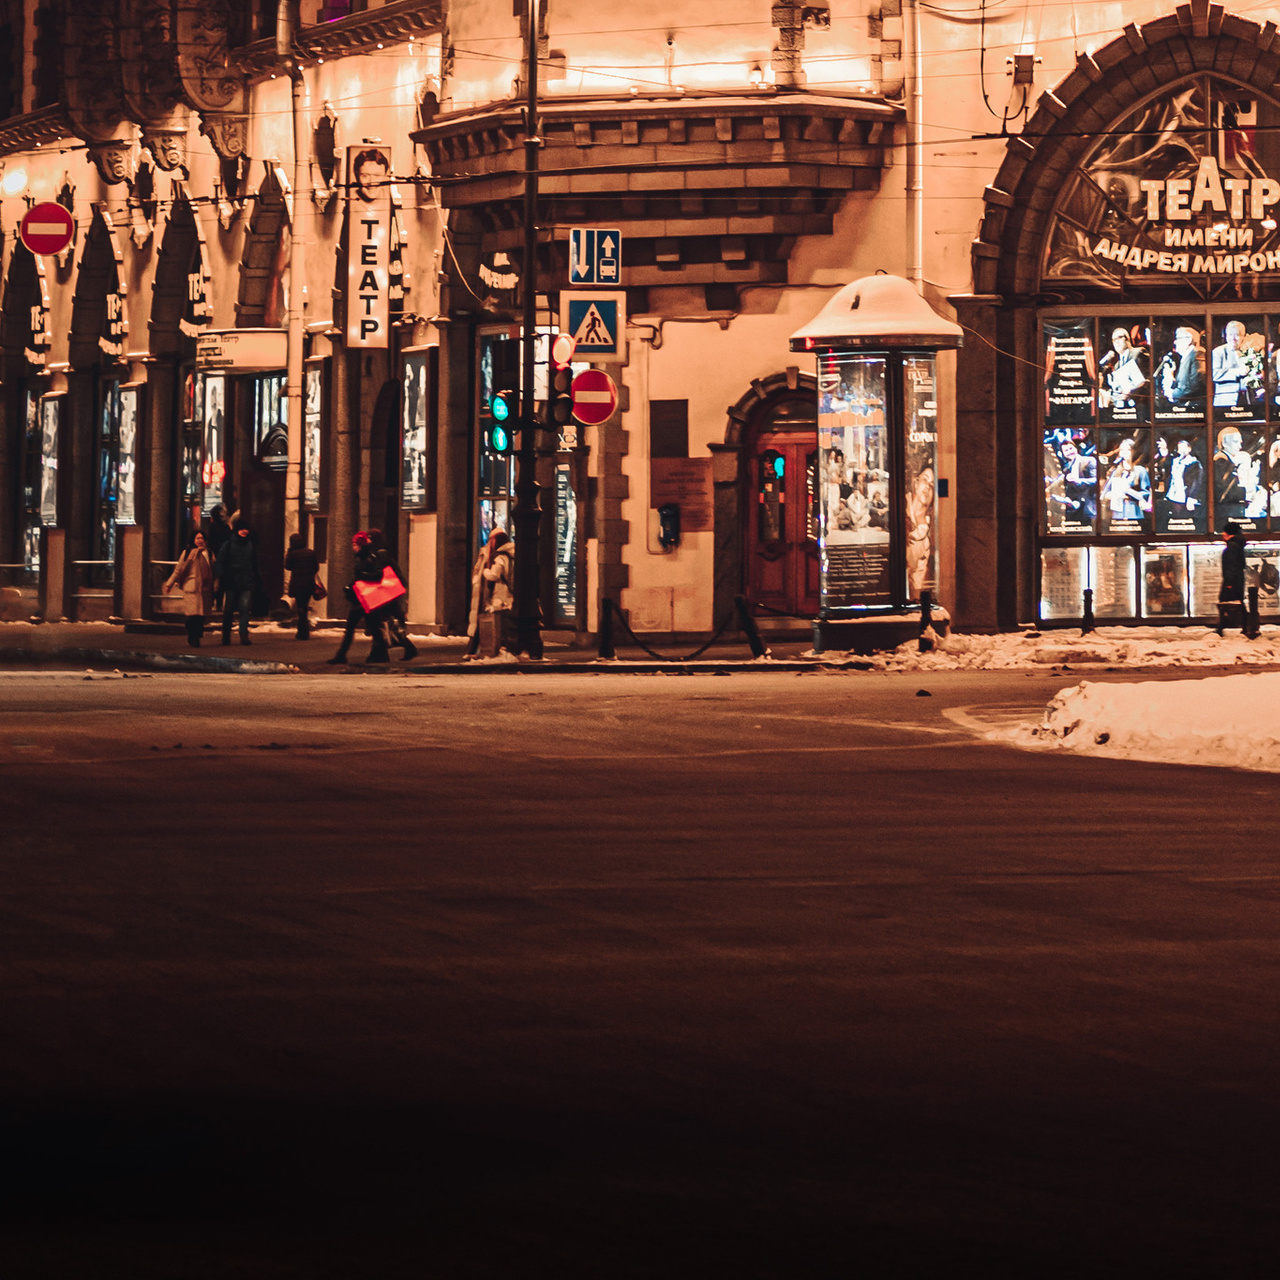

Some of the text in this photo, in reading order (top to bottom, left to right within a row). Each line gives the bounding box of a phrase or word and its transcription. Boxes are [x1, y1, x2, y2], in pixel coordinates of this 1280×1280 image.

[1164, 228, 1254, 247] ИМЕНИ
[1092, 238, 1190, 273] АНДРЕЯ
[358, 219, 380, 340] ТЕАТР
